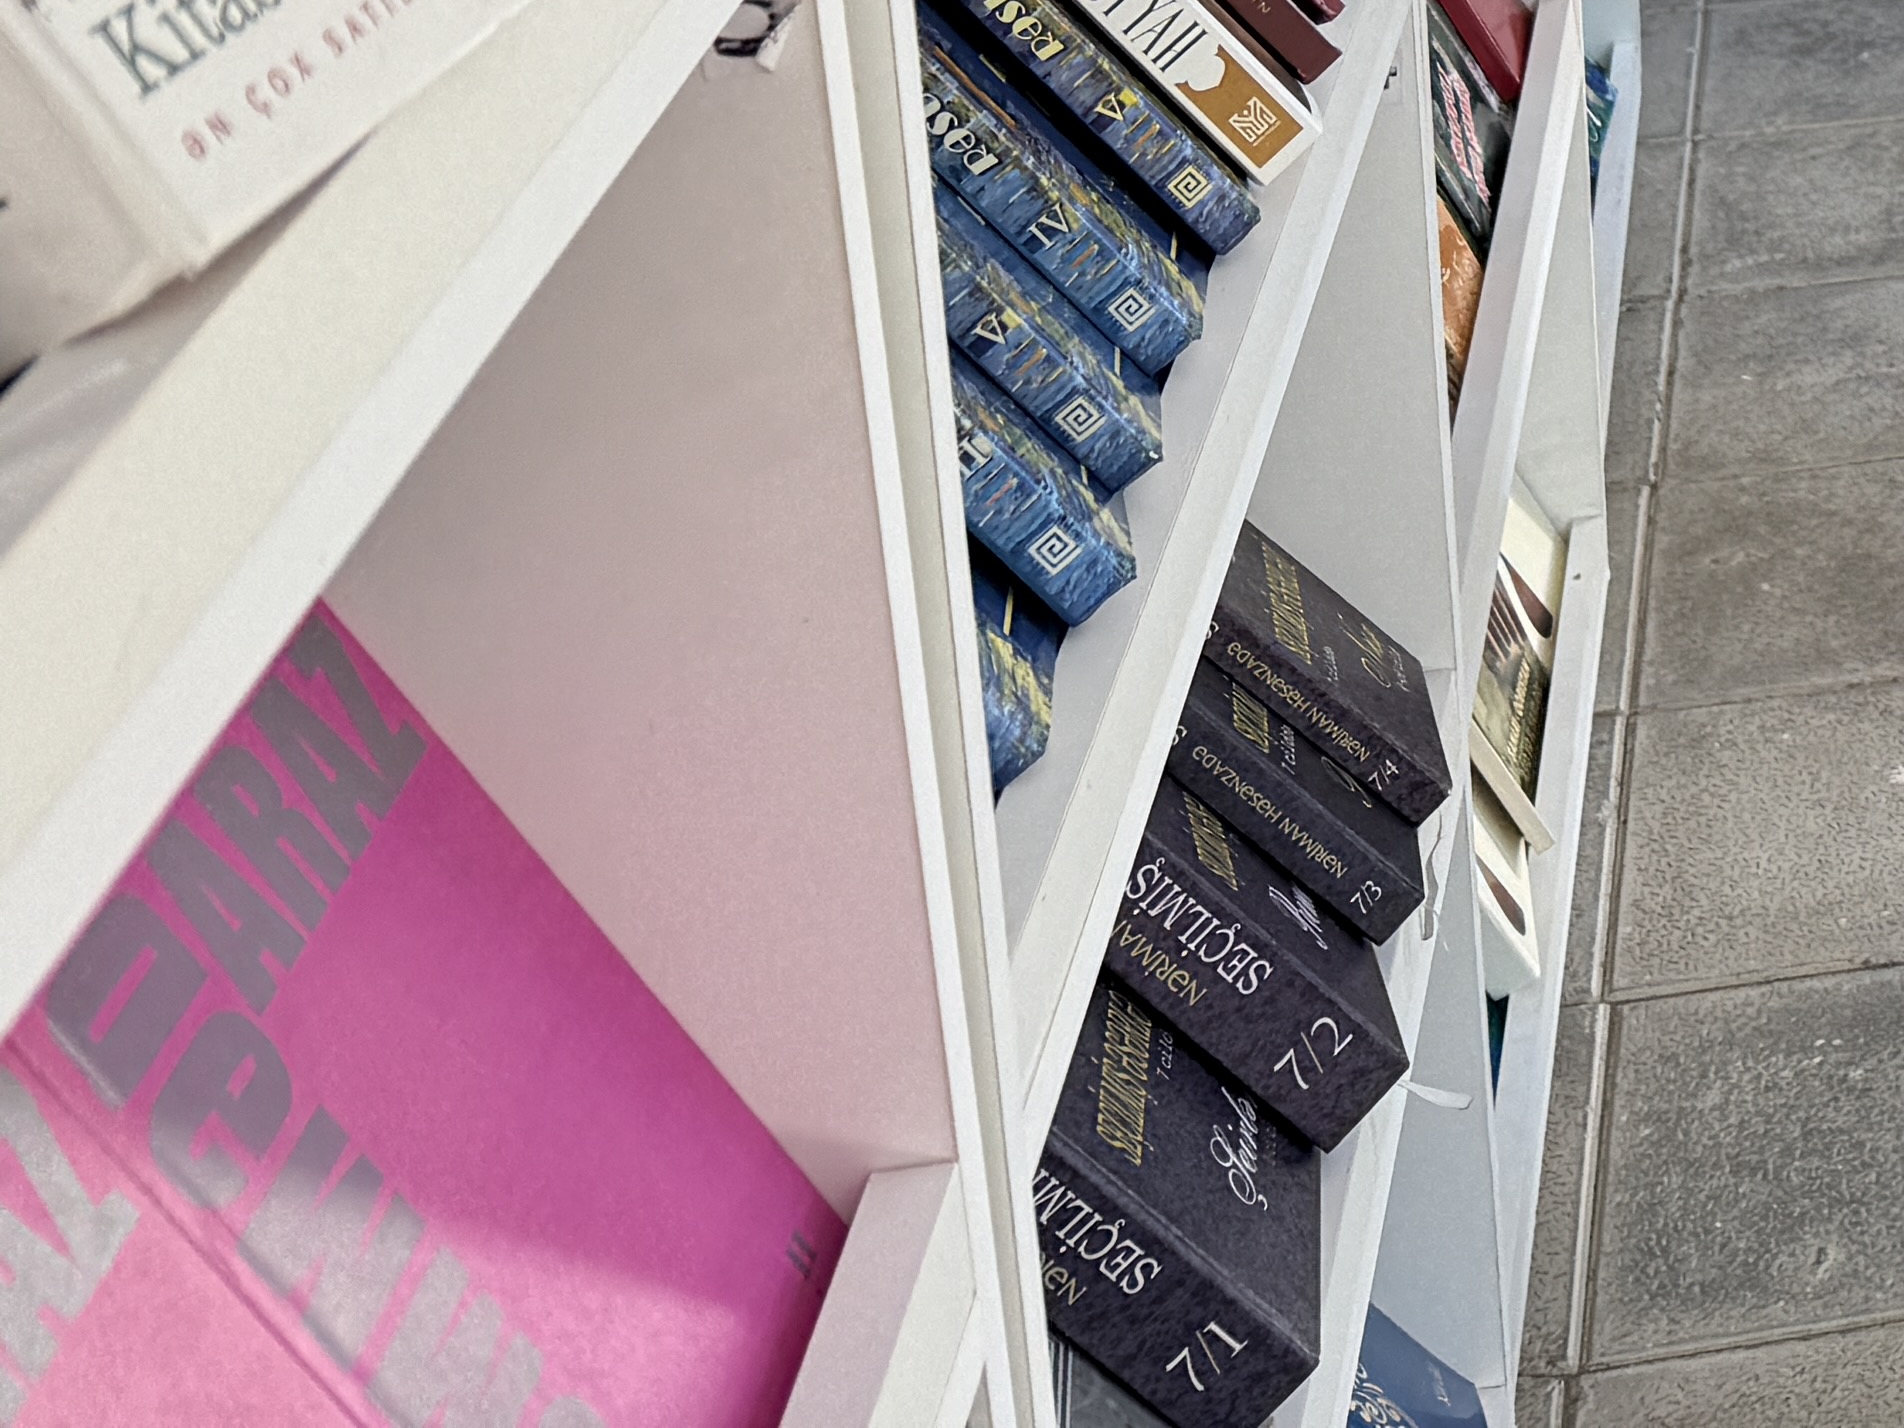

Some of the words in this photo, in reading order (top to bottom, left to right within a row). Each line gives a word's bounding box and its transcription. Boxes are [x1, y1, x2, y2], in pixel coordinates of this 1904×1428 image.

[922, 93, 999, 176] RƏSU
[1026, 202, 1071, 250] IV
[144, 612, 428, 1017] ARAZ
[1192, 745, 1283, 823] HƏSƏNZADƏ
[1278, 817, 1348, 879] NƏRİMAN
[1124, 857, 1274, 995] SEÇİLMİŞ
[1350, 880, 1382, 914] 7/3
[1273, 1016, 1353, 1090] 7/2
